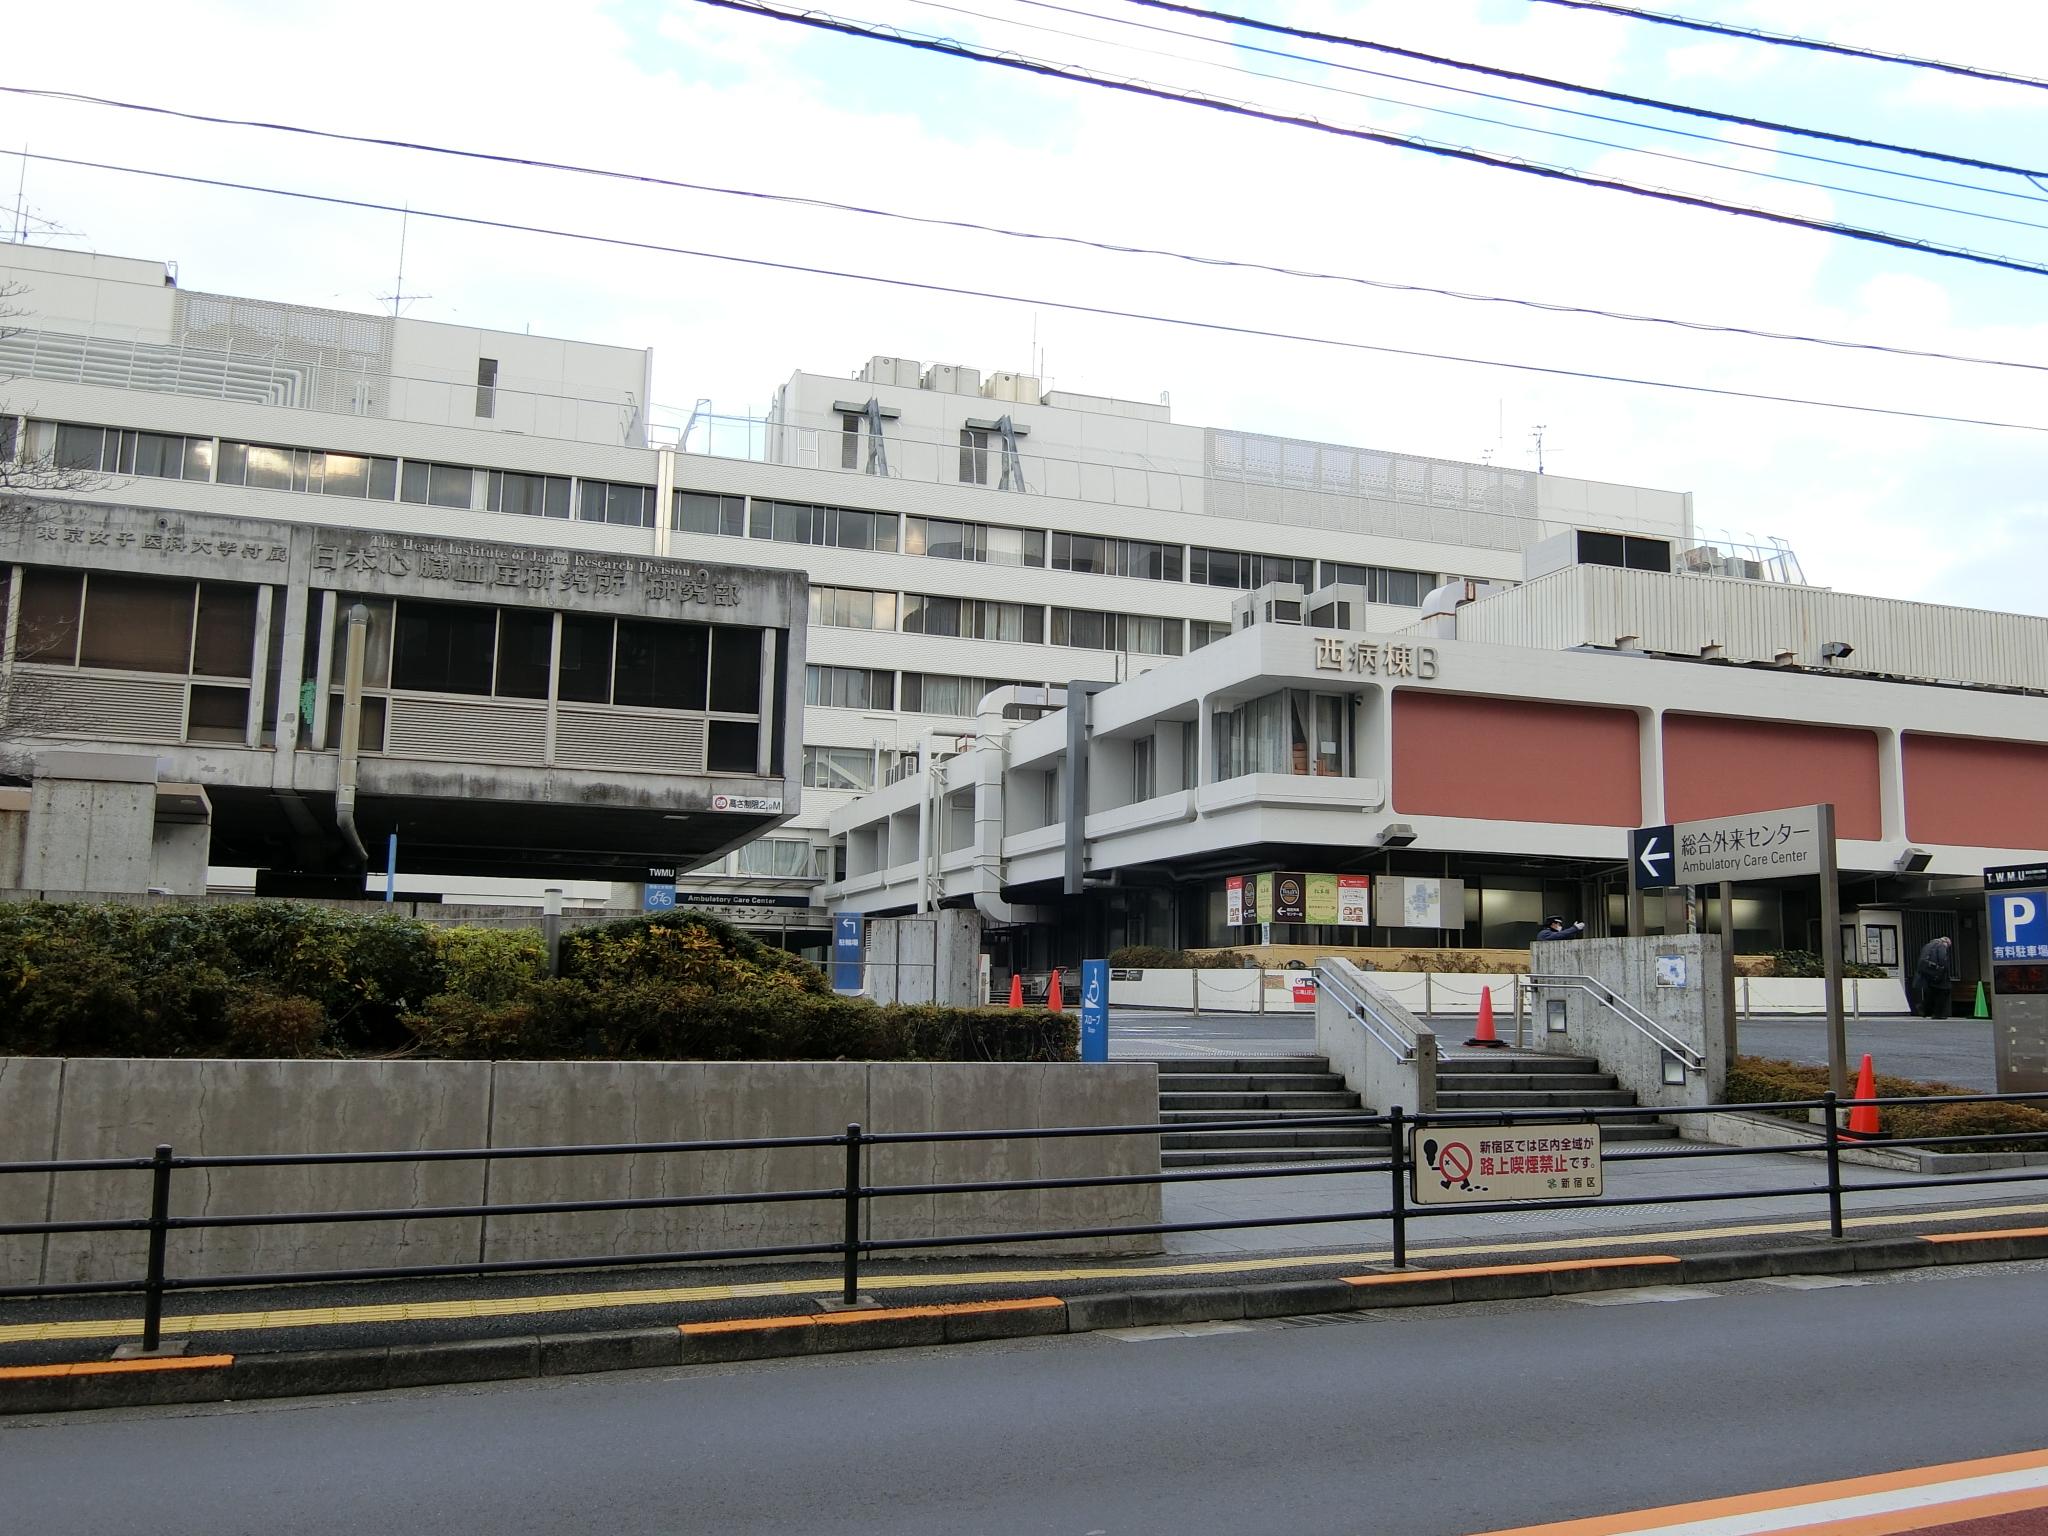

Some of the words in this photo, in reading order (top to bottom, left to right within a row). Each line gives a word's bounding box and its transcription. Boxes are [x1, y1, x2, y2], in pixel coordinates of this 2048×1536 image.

[36, 525, 289, 563] 東京女子医科大学付属
[370, 535, 397, 549] The
[403, 538, 441, 553] Heart
[449, 543, 507, 559] Institute
[511, 550, 527, 561] of
[530, 552, 570, 566] Japan
[574, 554, 634, 572] Research
[638, 561, 691, 577] Division
[646, 578, 741, 607] 研究部
[1315, 637, 1440, 680] 西病棟B
[1681, 823, 1811, 856] 総合外来センター
[649, 868, 675, 877] TWMU
[1683, 858, 1741, 873] Ambulatory
[1743, 853, 1768, 867] Care
[1771, 850, 1808, 864] Center
[687, 895, 731, 904] Ambulatory
[733, 896, 750, 904] Care
[751, 897, 776, 905] Center
[2004, 896, 2036, 943] P
[1993, 944, 2048, 959] 有料駐車場
[1084, 1014, 1100, 1025] スロープ
[1480, 1137, 1595, 1154] 新宿区では区内全域が
[1480, 1154, 1596, 1176] 路上喫煙禁止です。
[1561, 1177, 1596, 1189] 新宿区
